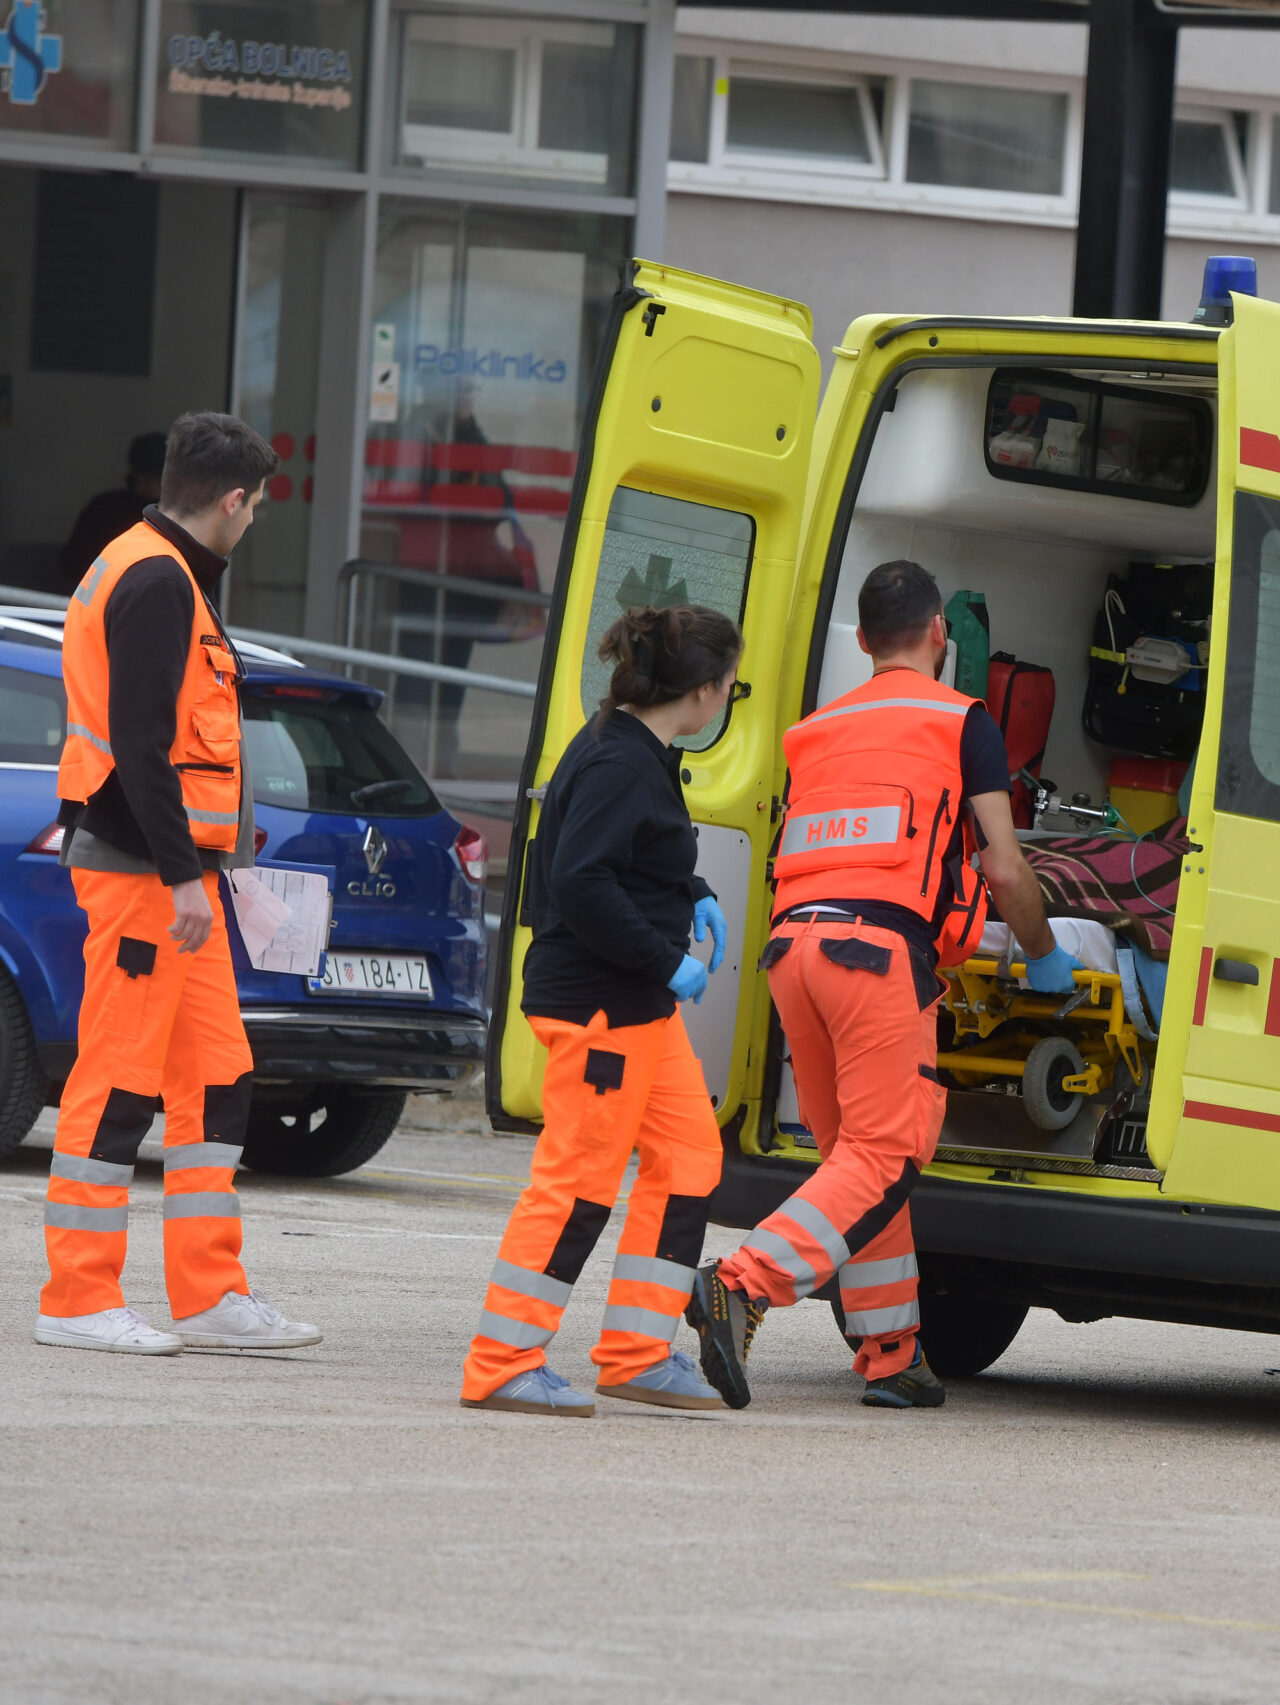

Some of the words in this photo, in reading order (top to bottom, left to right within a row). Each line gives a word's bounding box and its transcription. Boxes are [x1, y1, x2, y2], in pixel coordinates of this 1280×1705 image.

[168, 31, 239, 73] OPĆA
[242, 40, 352, 82] BOLNICA
[415, 344, 567, 383] Poliklinika
[806, 816, 869, 844] HMS
[347, 881, 396, 898] CLIO
